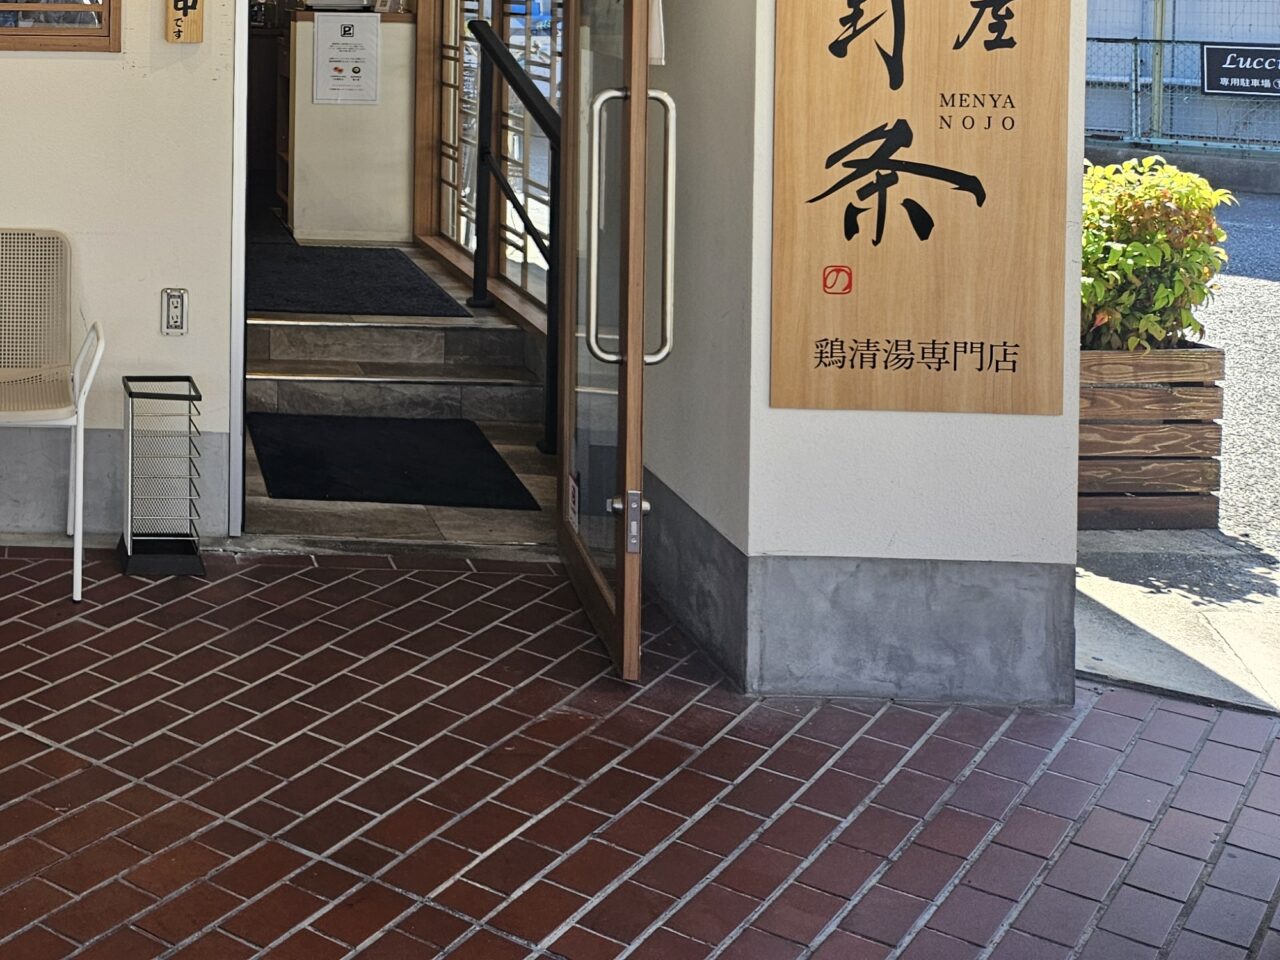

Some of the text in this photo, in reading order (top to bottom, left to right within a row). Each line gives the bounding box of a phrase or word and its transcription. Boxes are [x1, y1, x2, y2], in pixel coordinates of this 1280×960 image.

[939, 93, 1016, 109] MENYA
[938, 115, 1016, 131] NOJO
[823, 266, 852, 293] の
[813, 337, 1020, 373] 鶏清湯専門店
